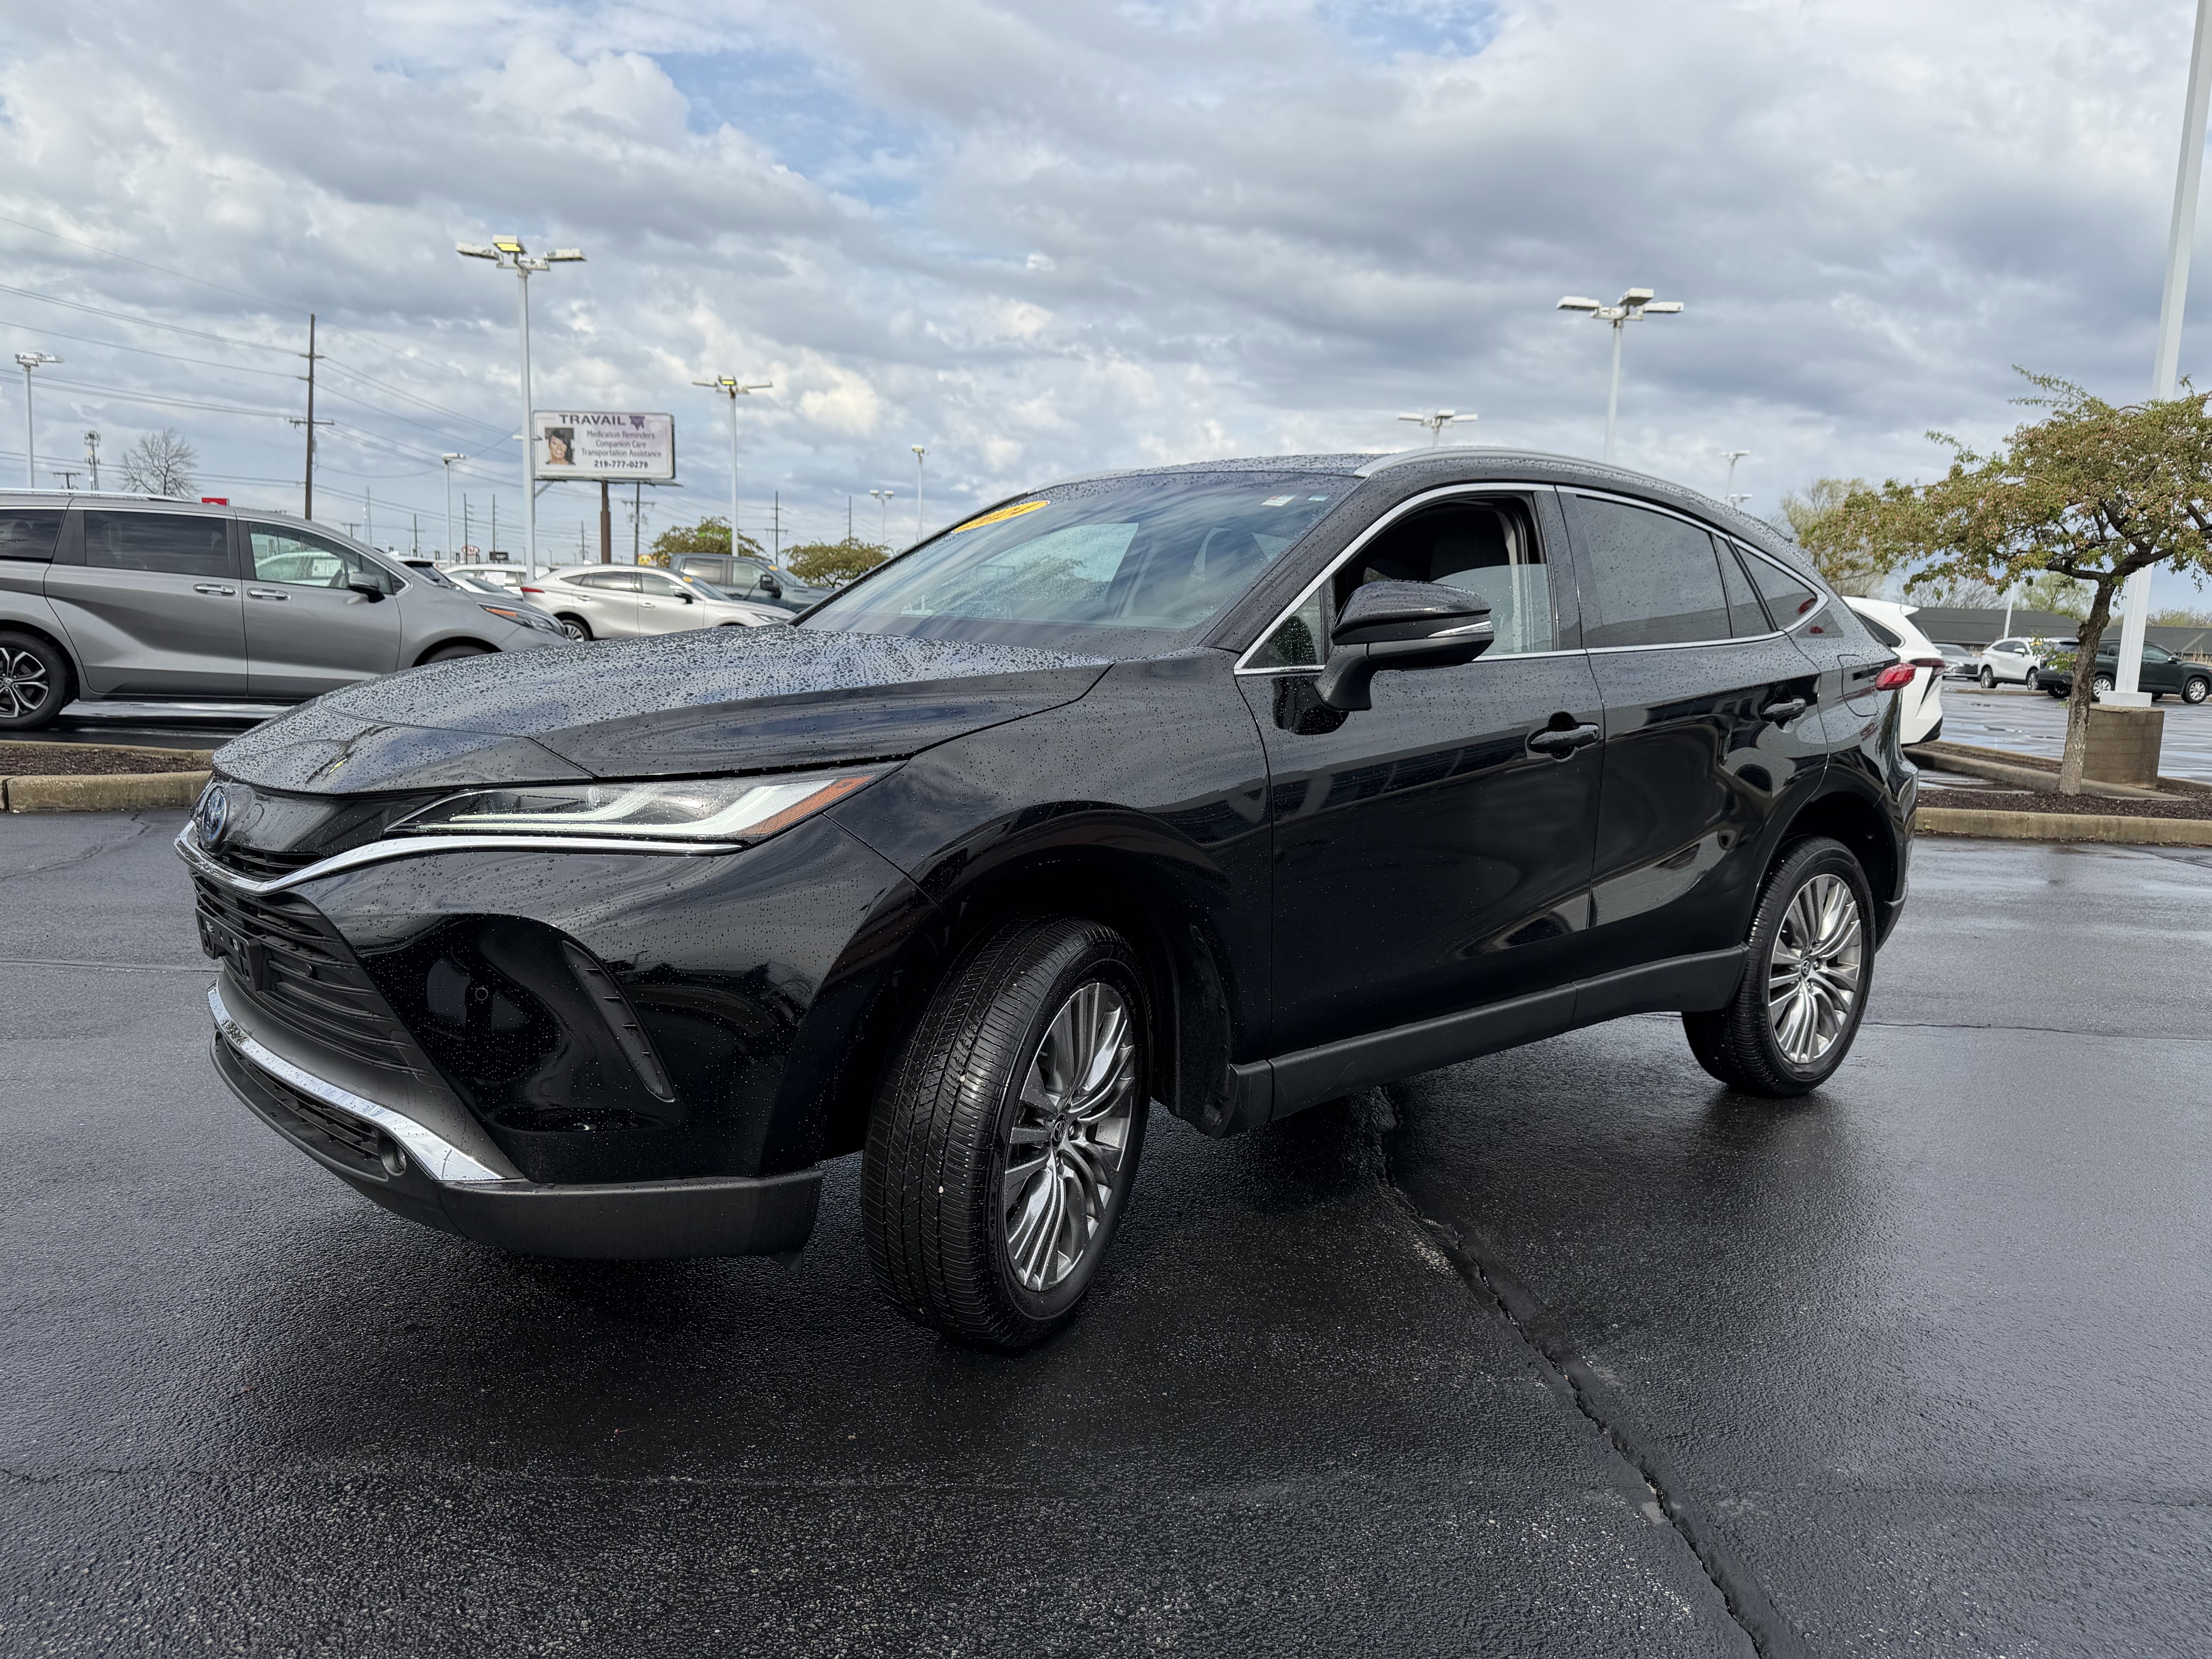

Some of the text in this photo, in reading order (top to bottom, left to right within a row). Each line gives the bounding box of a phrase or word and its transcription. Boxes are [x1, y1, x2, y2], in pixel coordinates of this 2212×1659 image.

[560, 414, 626, 425] TRAVAIL
[587, 430, 655, 439] Medication Reminders
[596, 440, 630, 448] Companion
[582, 448, 662, 458] Transportation Assistance
